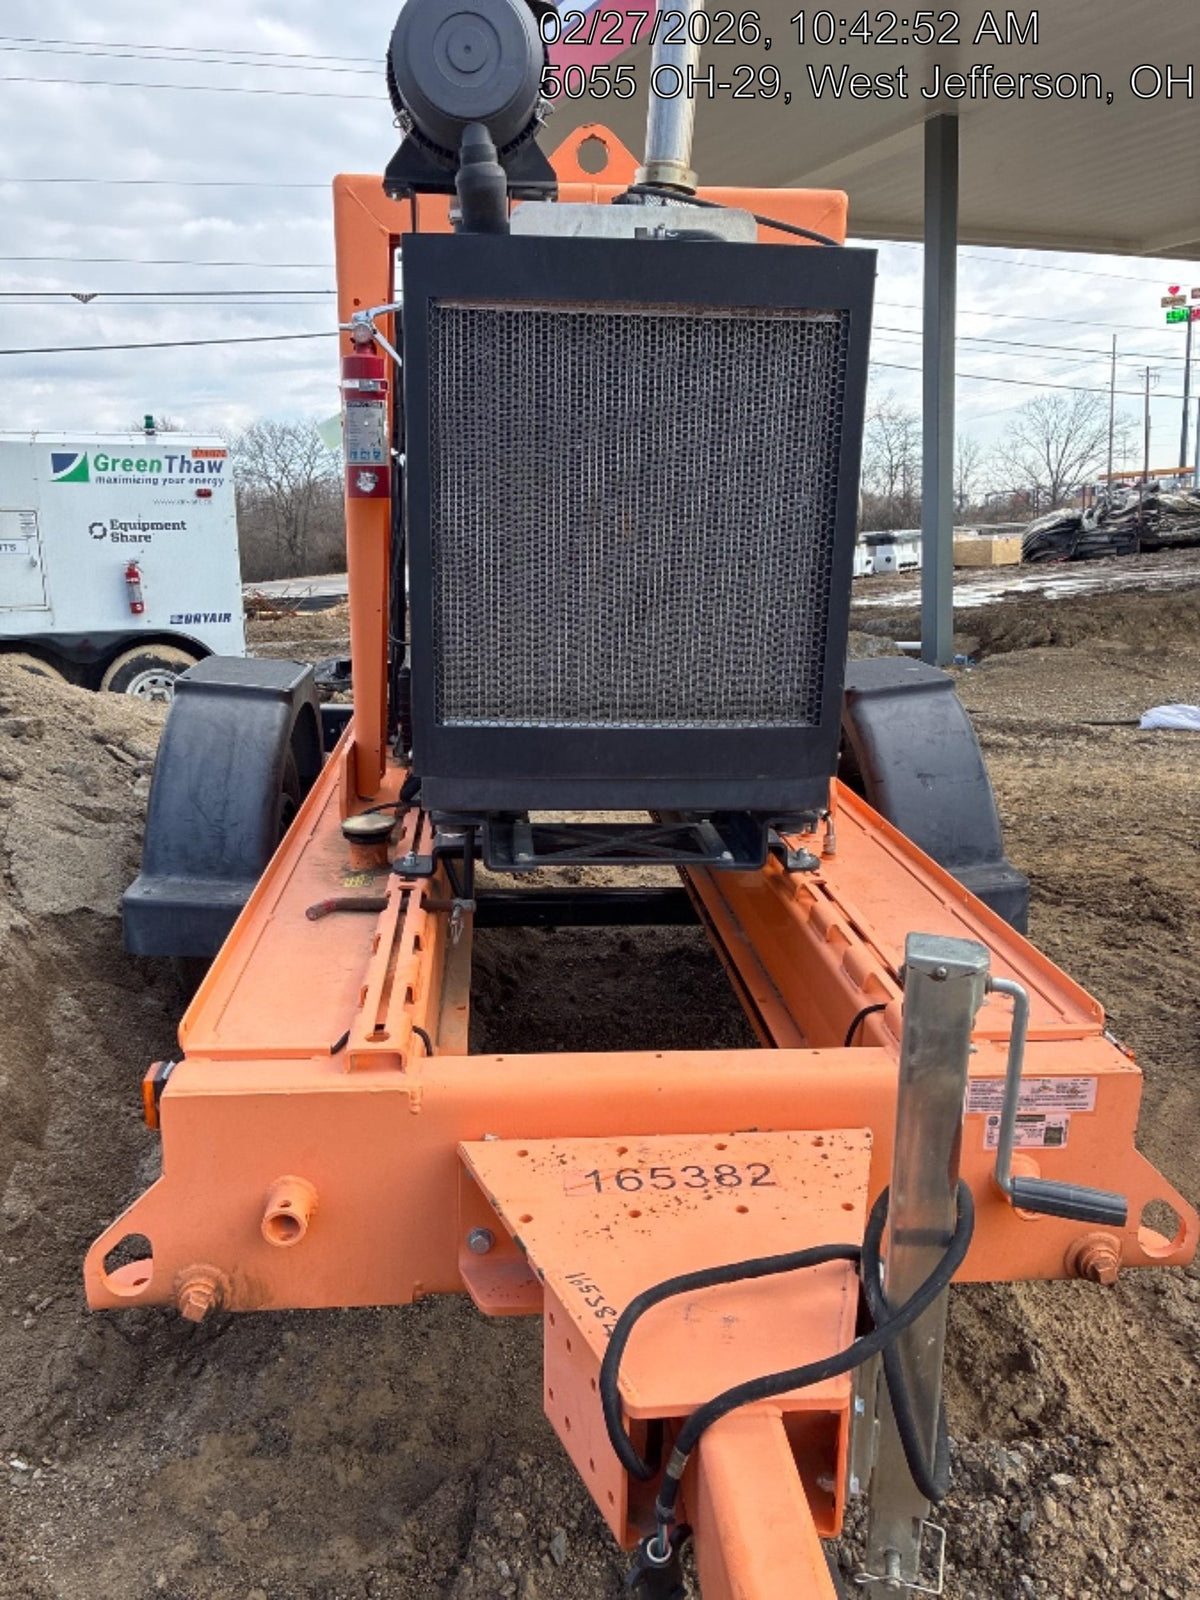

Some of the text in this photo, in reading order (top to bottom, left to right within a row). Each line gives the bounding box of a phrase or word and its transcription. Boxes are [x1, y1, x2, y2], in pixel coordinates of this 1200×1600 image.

[162, 477, 186, 486] your
[188, 477, 225, 487] energy
[109, 519, 187, 532] Equipment
[110, 532, 152, 543] Share
[584, 1162, 777, 1193] 165382
